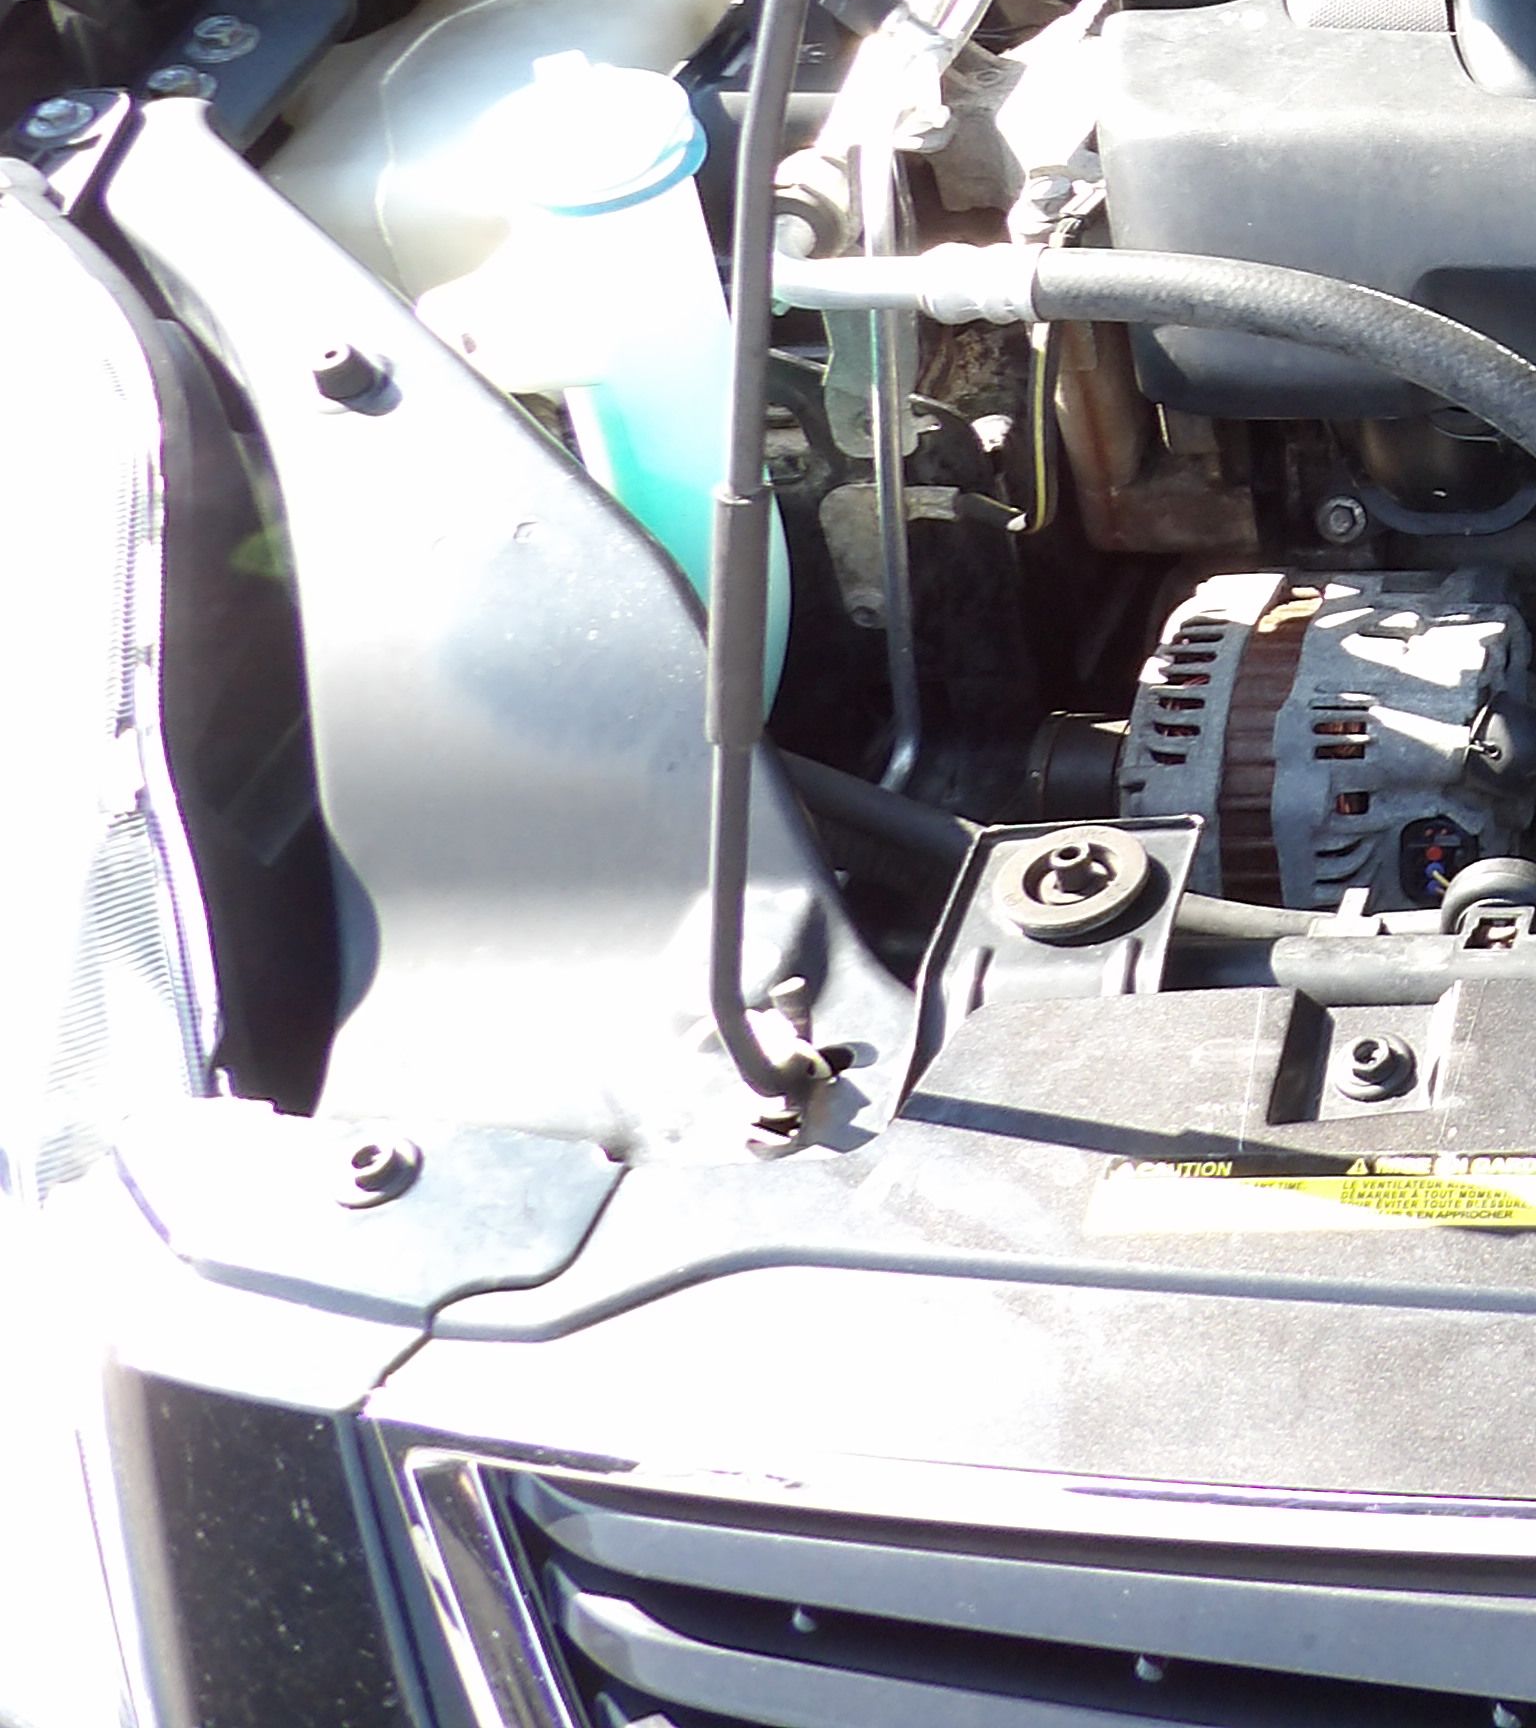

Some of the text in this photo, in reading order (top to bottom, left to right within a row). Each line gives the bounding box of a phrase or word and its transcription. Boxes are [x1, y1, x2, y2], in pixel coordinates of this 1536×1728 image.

[1135, 1161, 1233, 1178] CAUTION
[1424, 1190, 1454, 1199] TOUT
[1423, 1199, 1461, 1209] TOUTE
